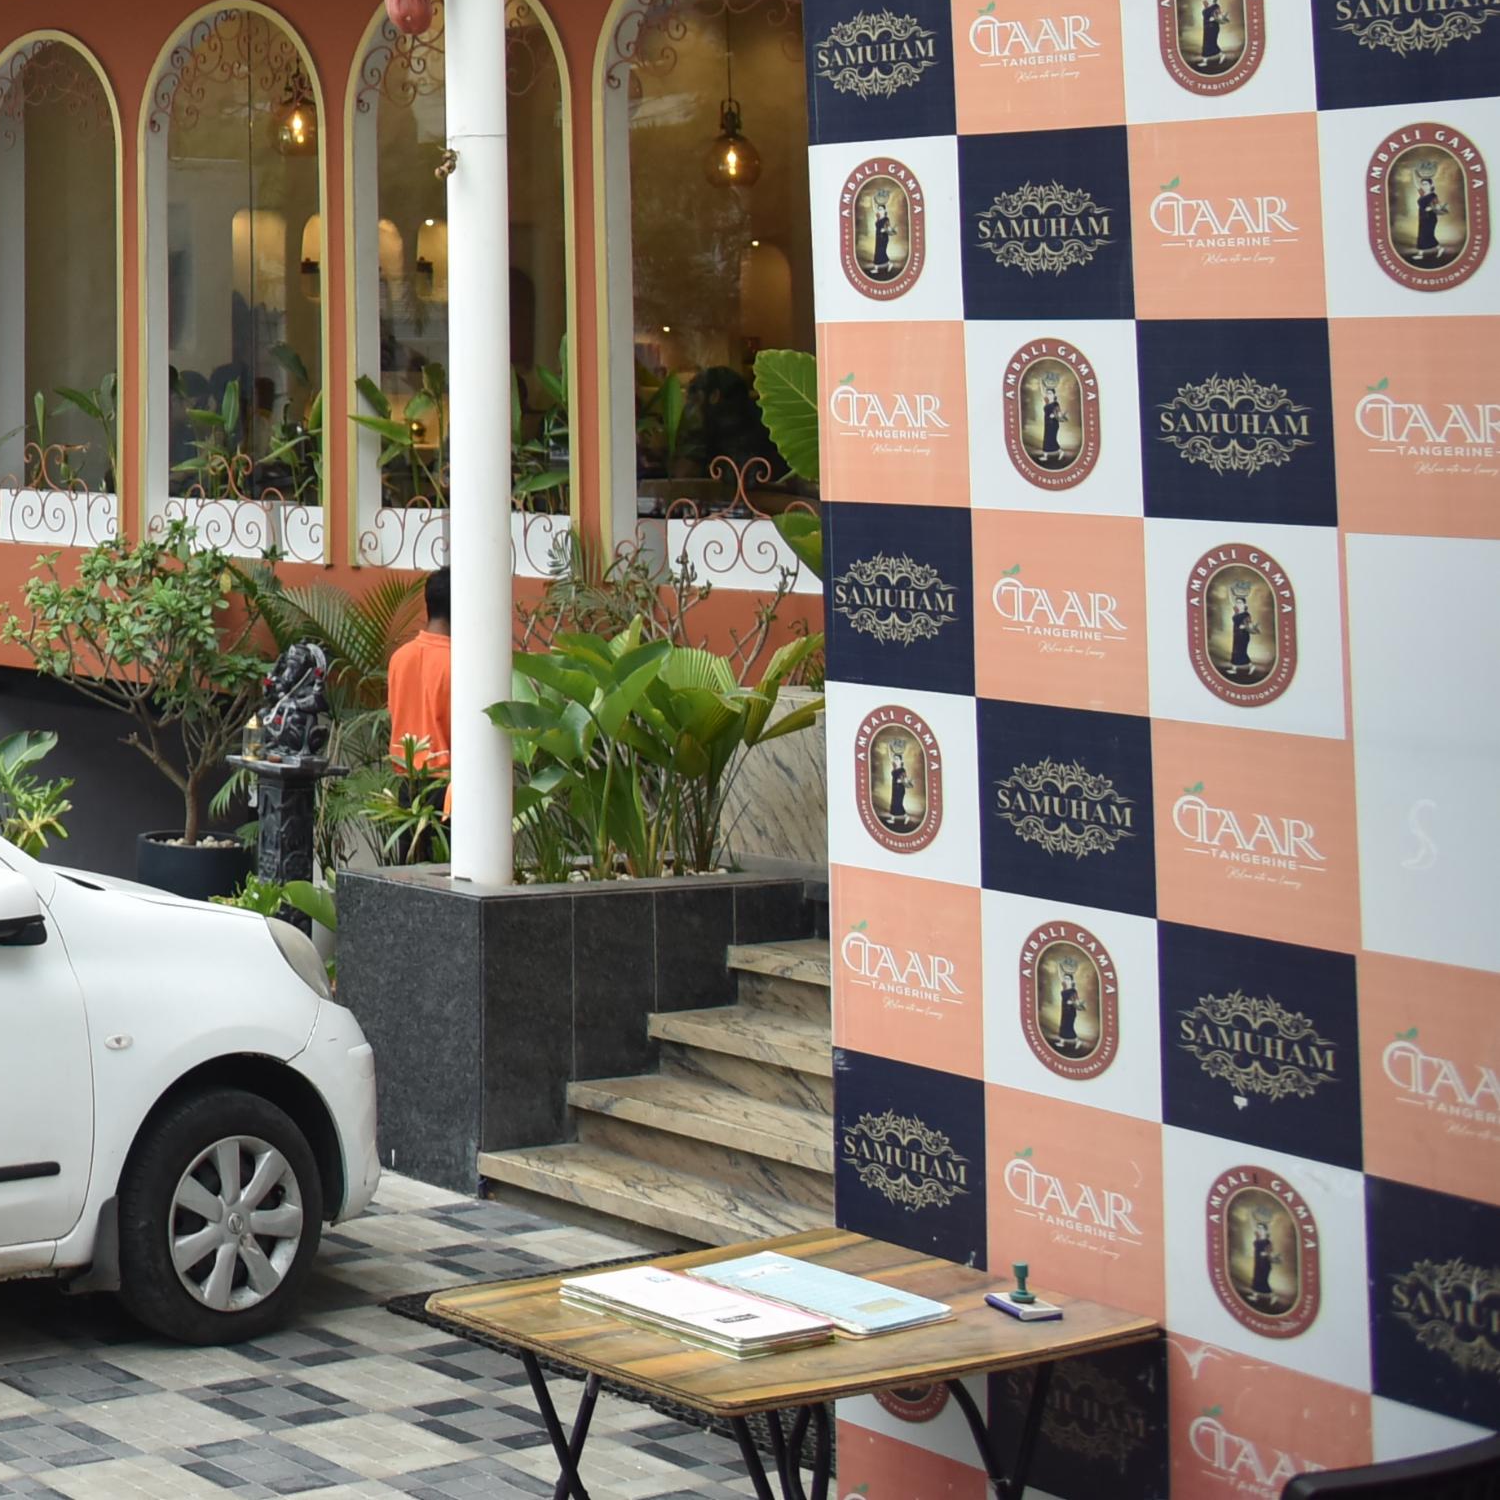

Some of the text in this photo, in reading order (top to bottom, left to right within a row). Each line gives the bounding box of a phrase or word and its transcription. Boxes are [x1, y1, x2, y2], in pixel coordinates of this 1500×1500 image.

[817, 39, 936, 68] SAMUHAM
[1002, 53, 1077, 68] TANGERINE
[1369, 129, 1485, 194] AMBALI GAMPA
[841, 163, 923, 218] AMBALI GAMPA
[977, 215, 1110, 240] SAMUHAM
[1187, 237, 1272, 248] TANGERINE
[1005, 343, 1096, 400] AMBALI GAMPA
[859, 429, 928, 439] TANGERINE
[1159, 411, 1310, 436] SAMUHAM
[1397, 445, 1494, 457] TANGERINE
[1189, 548, 1293, 614] AMBALI GAMPA
[834, 585, 955, 613] SAMUHAM
[1022, 625, 1103, 642] TANGERINE
[857, 710, 940, 771] AMBALI GAMPA
[996, 788, 1133, 828] SAMUHAM
[1208, 847, 1298, 871] TANGERINE
[1022, 926, 1116, 994] AMBALI GAMPA
[870, 980, 940, 1003] TANGERINE
[1179, 1018, 1337, 1072] SAMUHAM
[1425, 1098, 1500, 1125] TANGER
[843, 1134, 967, 1186] SAMUHAM
[1036, 1211, 1117, 1241] TANGERINE
[1269, 1180, 1316, 1249] GAMPA
